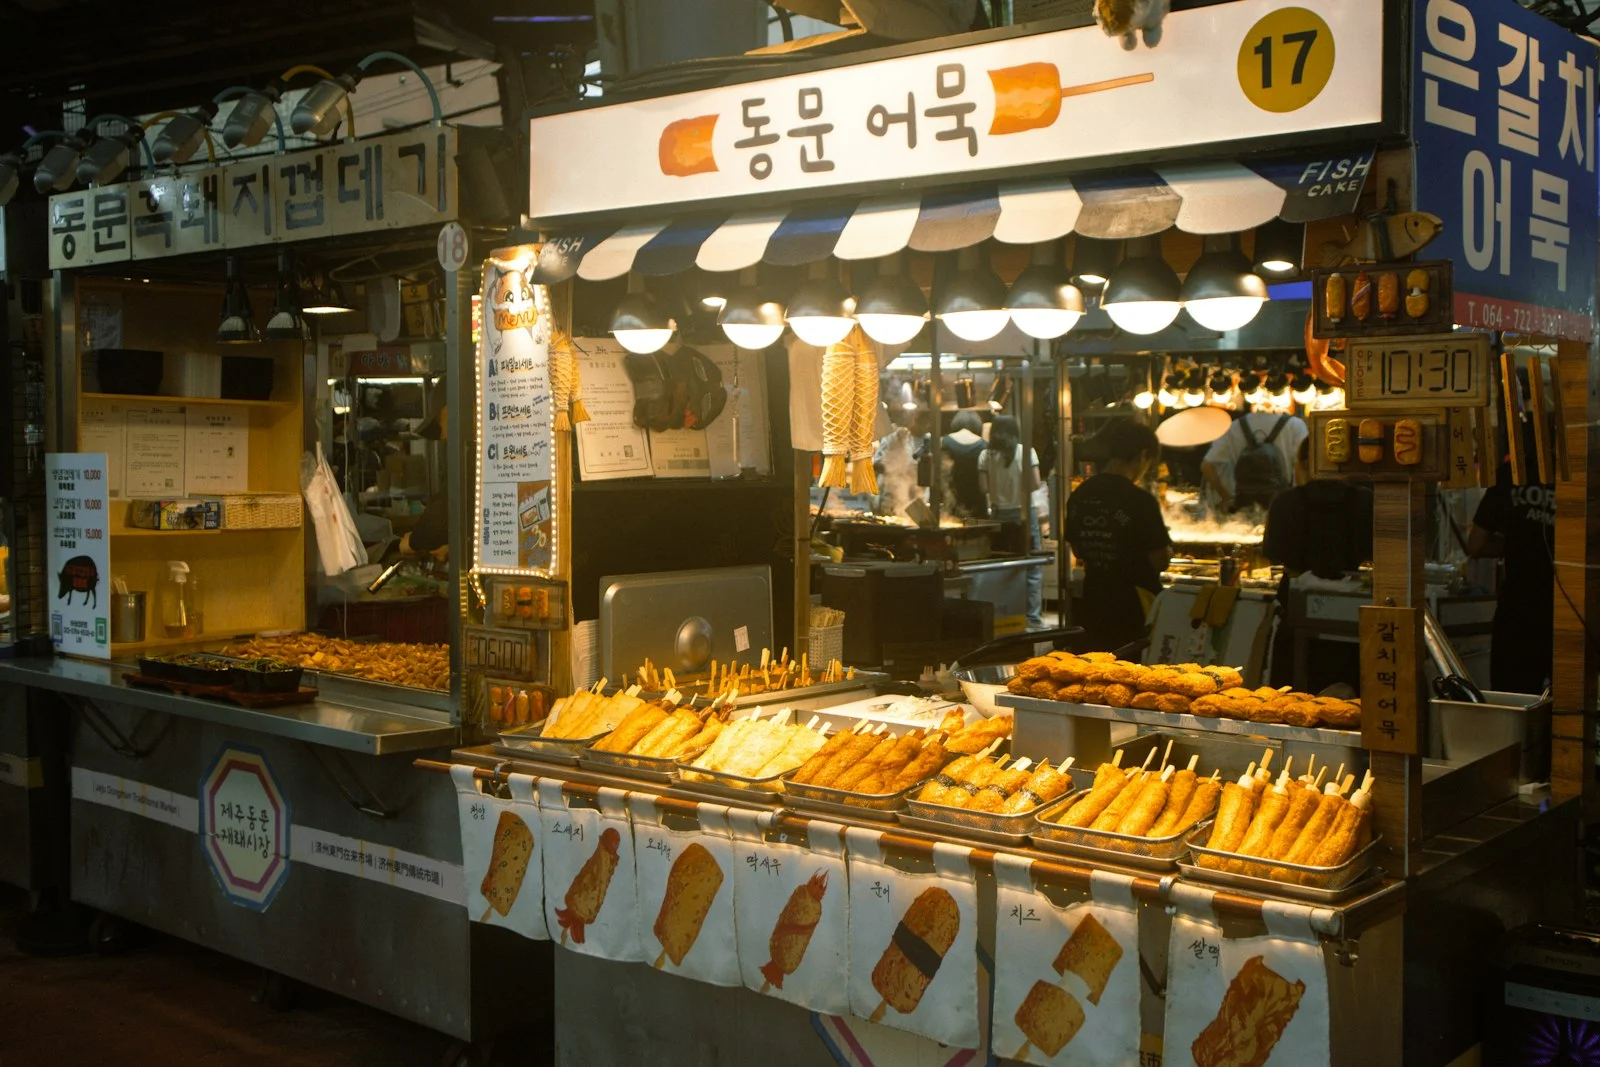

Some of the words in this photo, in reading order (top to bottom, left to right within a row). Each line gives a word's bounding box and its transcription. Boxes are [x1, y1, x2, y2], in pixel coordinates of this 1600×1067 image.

[1253, 29, 1318, 90] 17
[1422, 0, 1594, 173] 은갈치
[734, 87, 836, 181] 동문
[866, 62, 979, 158] 어묵
[1299, 156, 1370, 185] FISH
[1307, 179, 1360, 198] CAKE
[1462, 150, 1571, 293] 어묵
[438, 229, 467, 264] 18
[1356, 350, 1365, 398] CLOSE
[1381, 348, 1472, 395] 10:30
[551, 819, 585, 842] 소세지
[746, 851, 782, 877] 딱새우
[870, 880, 891, 903] 문어
[1009, 903, 1042, 927] 치즈
